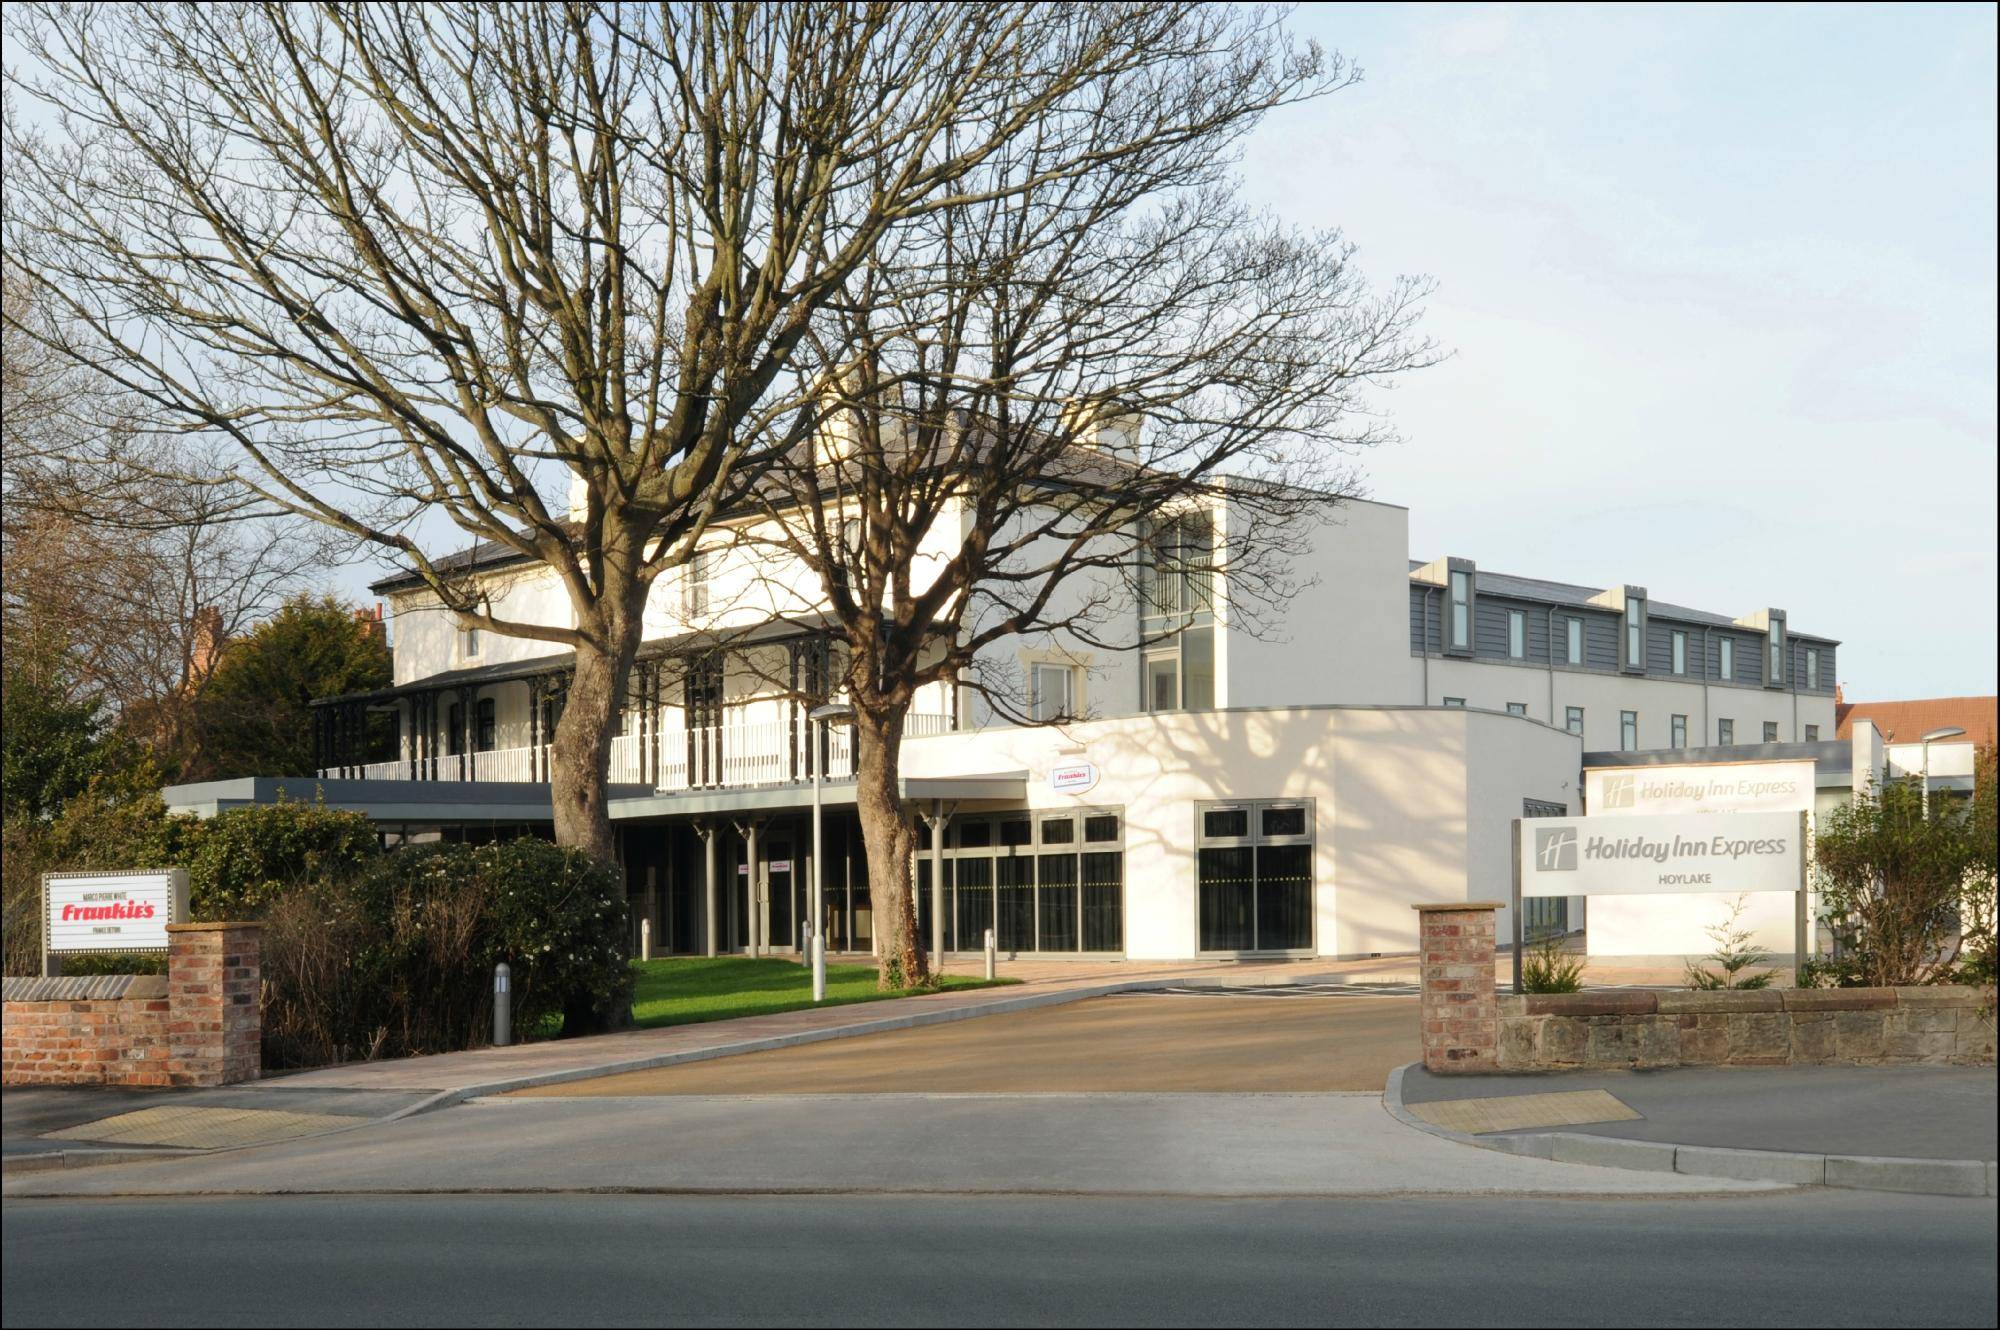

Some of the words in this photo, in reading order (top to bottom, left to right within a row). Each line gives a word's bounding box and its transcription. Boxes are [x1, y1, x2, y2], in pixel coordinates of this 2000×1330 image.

[1640, 782, 1704, 800] Holiday
[1708, 779, 1734, 796] Inn
[1738, 779, 1796, 797] Express
[1585, 836, 1669, 863] Holiday
[1673, 835, 1706, 857] Inn
[1711, 836, 1786, 860] Express
[1658, 873, 1712, 885] HOYLAKE
